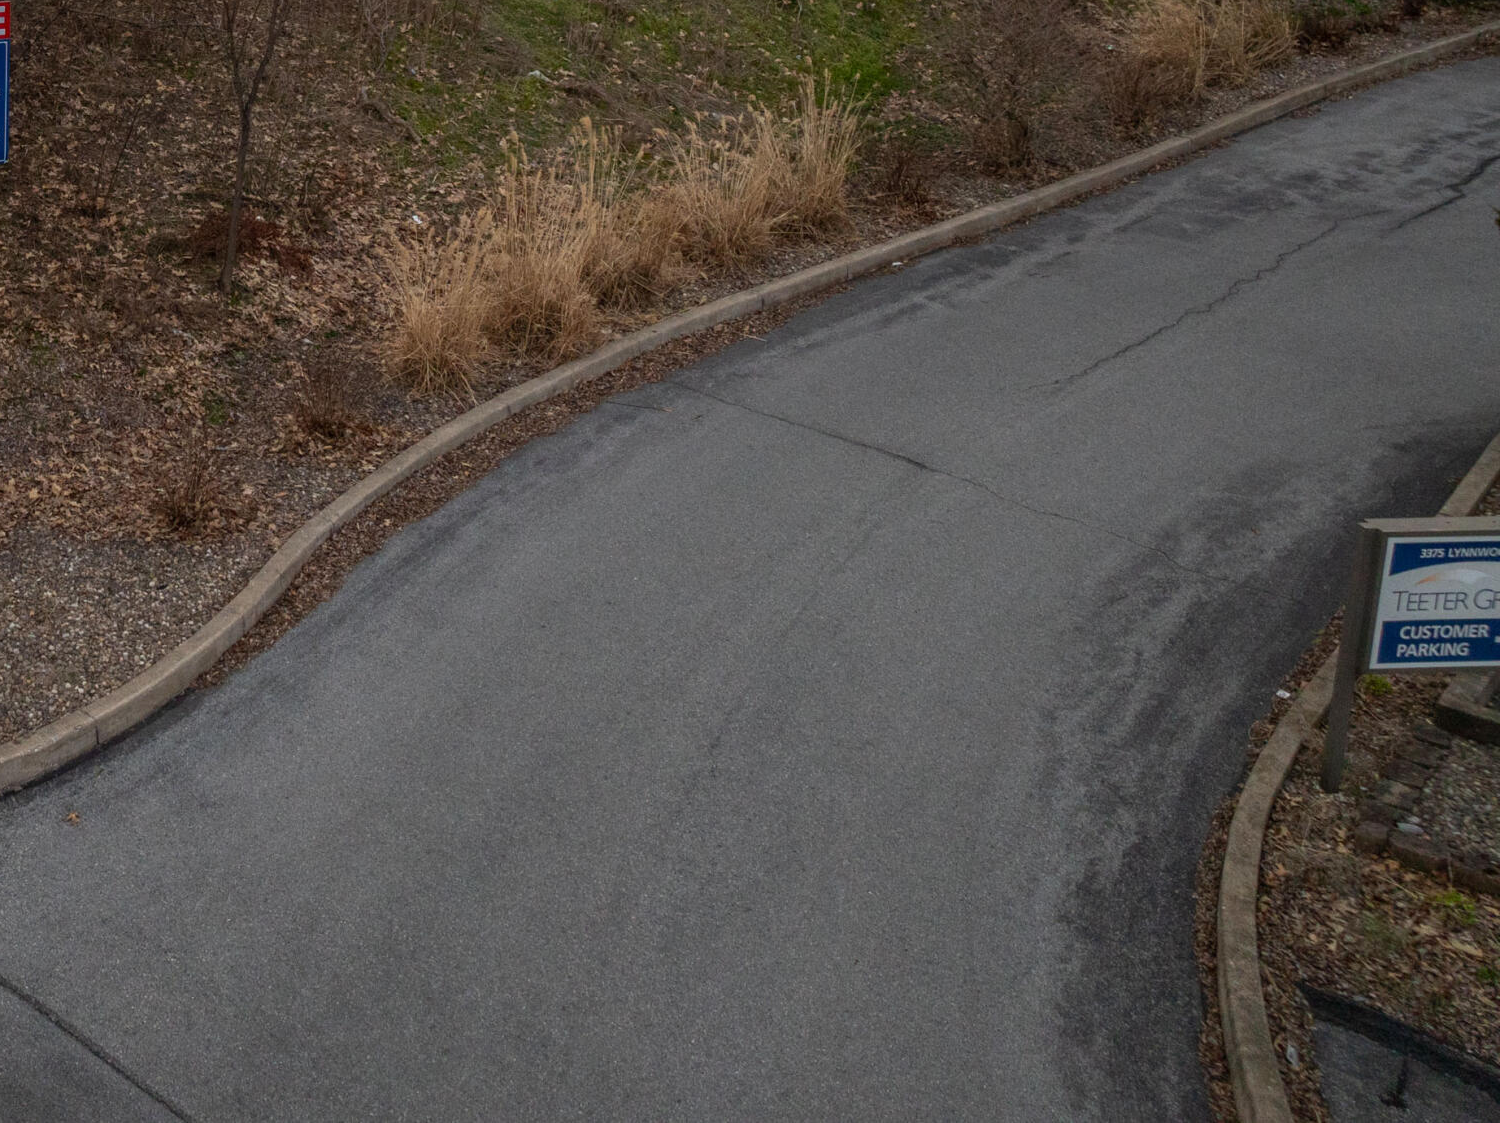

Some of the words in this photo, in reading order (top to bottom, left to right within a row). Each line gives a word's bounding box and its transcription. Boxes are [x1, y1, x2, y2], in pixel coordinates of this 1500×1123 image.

[1420, 548, 1445, 558] 3375
[1393, 591, 1468, 611] TEETER
[1400, 624, 1490, 639] CUSTOMER
[1396, 642, 1470, 657] PARKING
